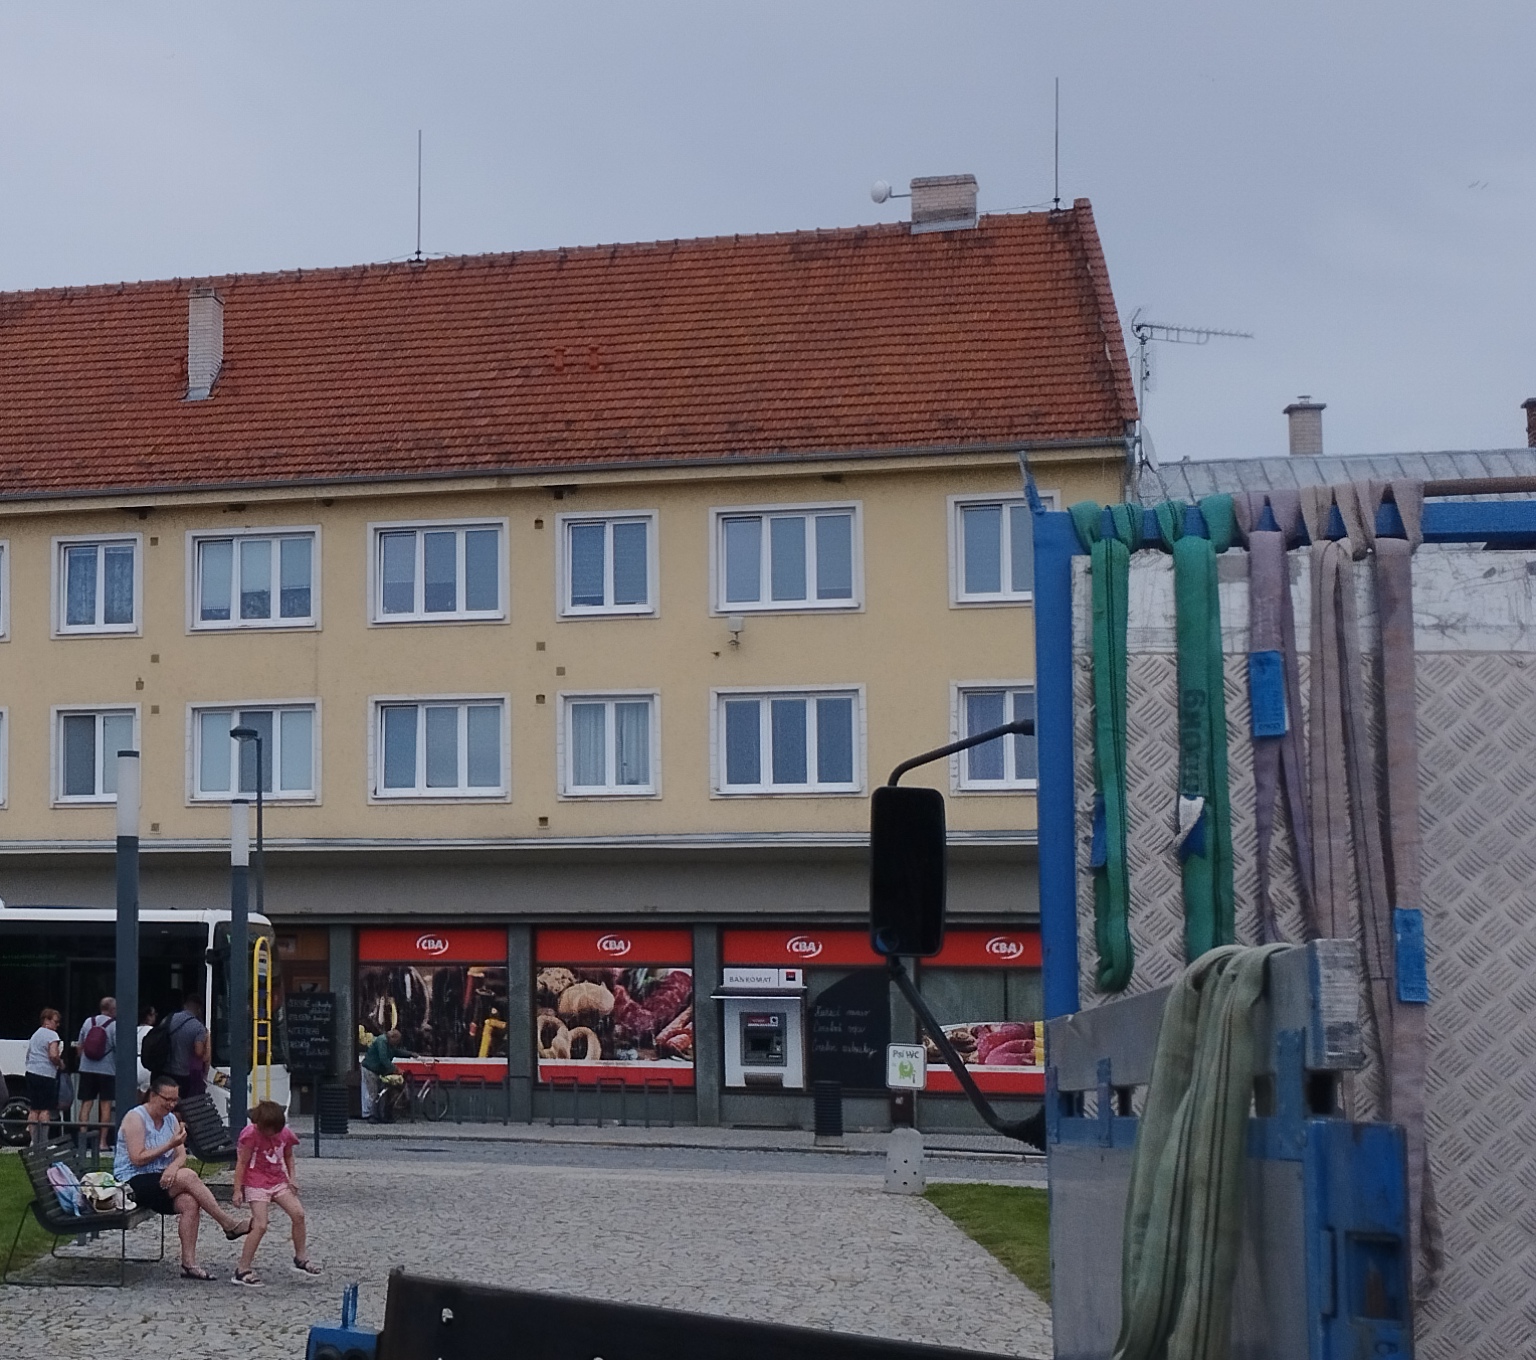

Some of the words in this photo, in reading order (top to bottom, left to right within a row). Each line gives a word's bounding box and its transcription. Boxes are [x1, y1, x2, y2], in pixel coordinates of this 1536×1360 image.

[419, 938, 445, 952] CBA
[601, 938, 626, 952] CBA
[791, 939, 817, 953] CBA
[990, 941, 1018, 955] CBA
[729, 975, 772, 983] BANKOMAT
[906, 1050, 920, 1059] WC
